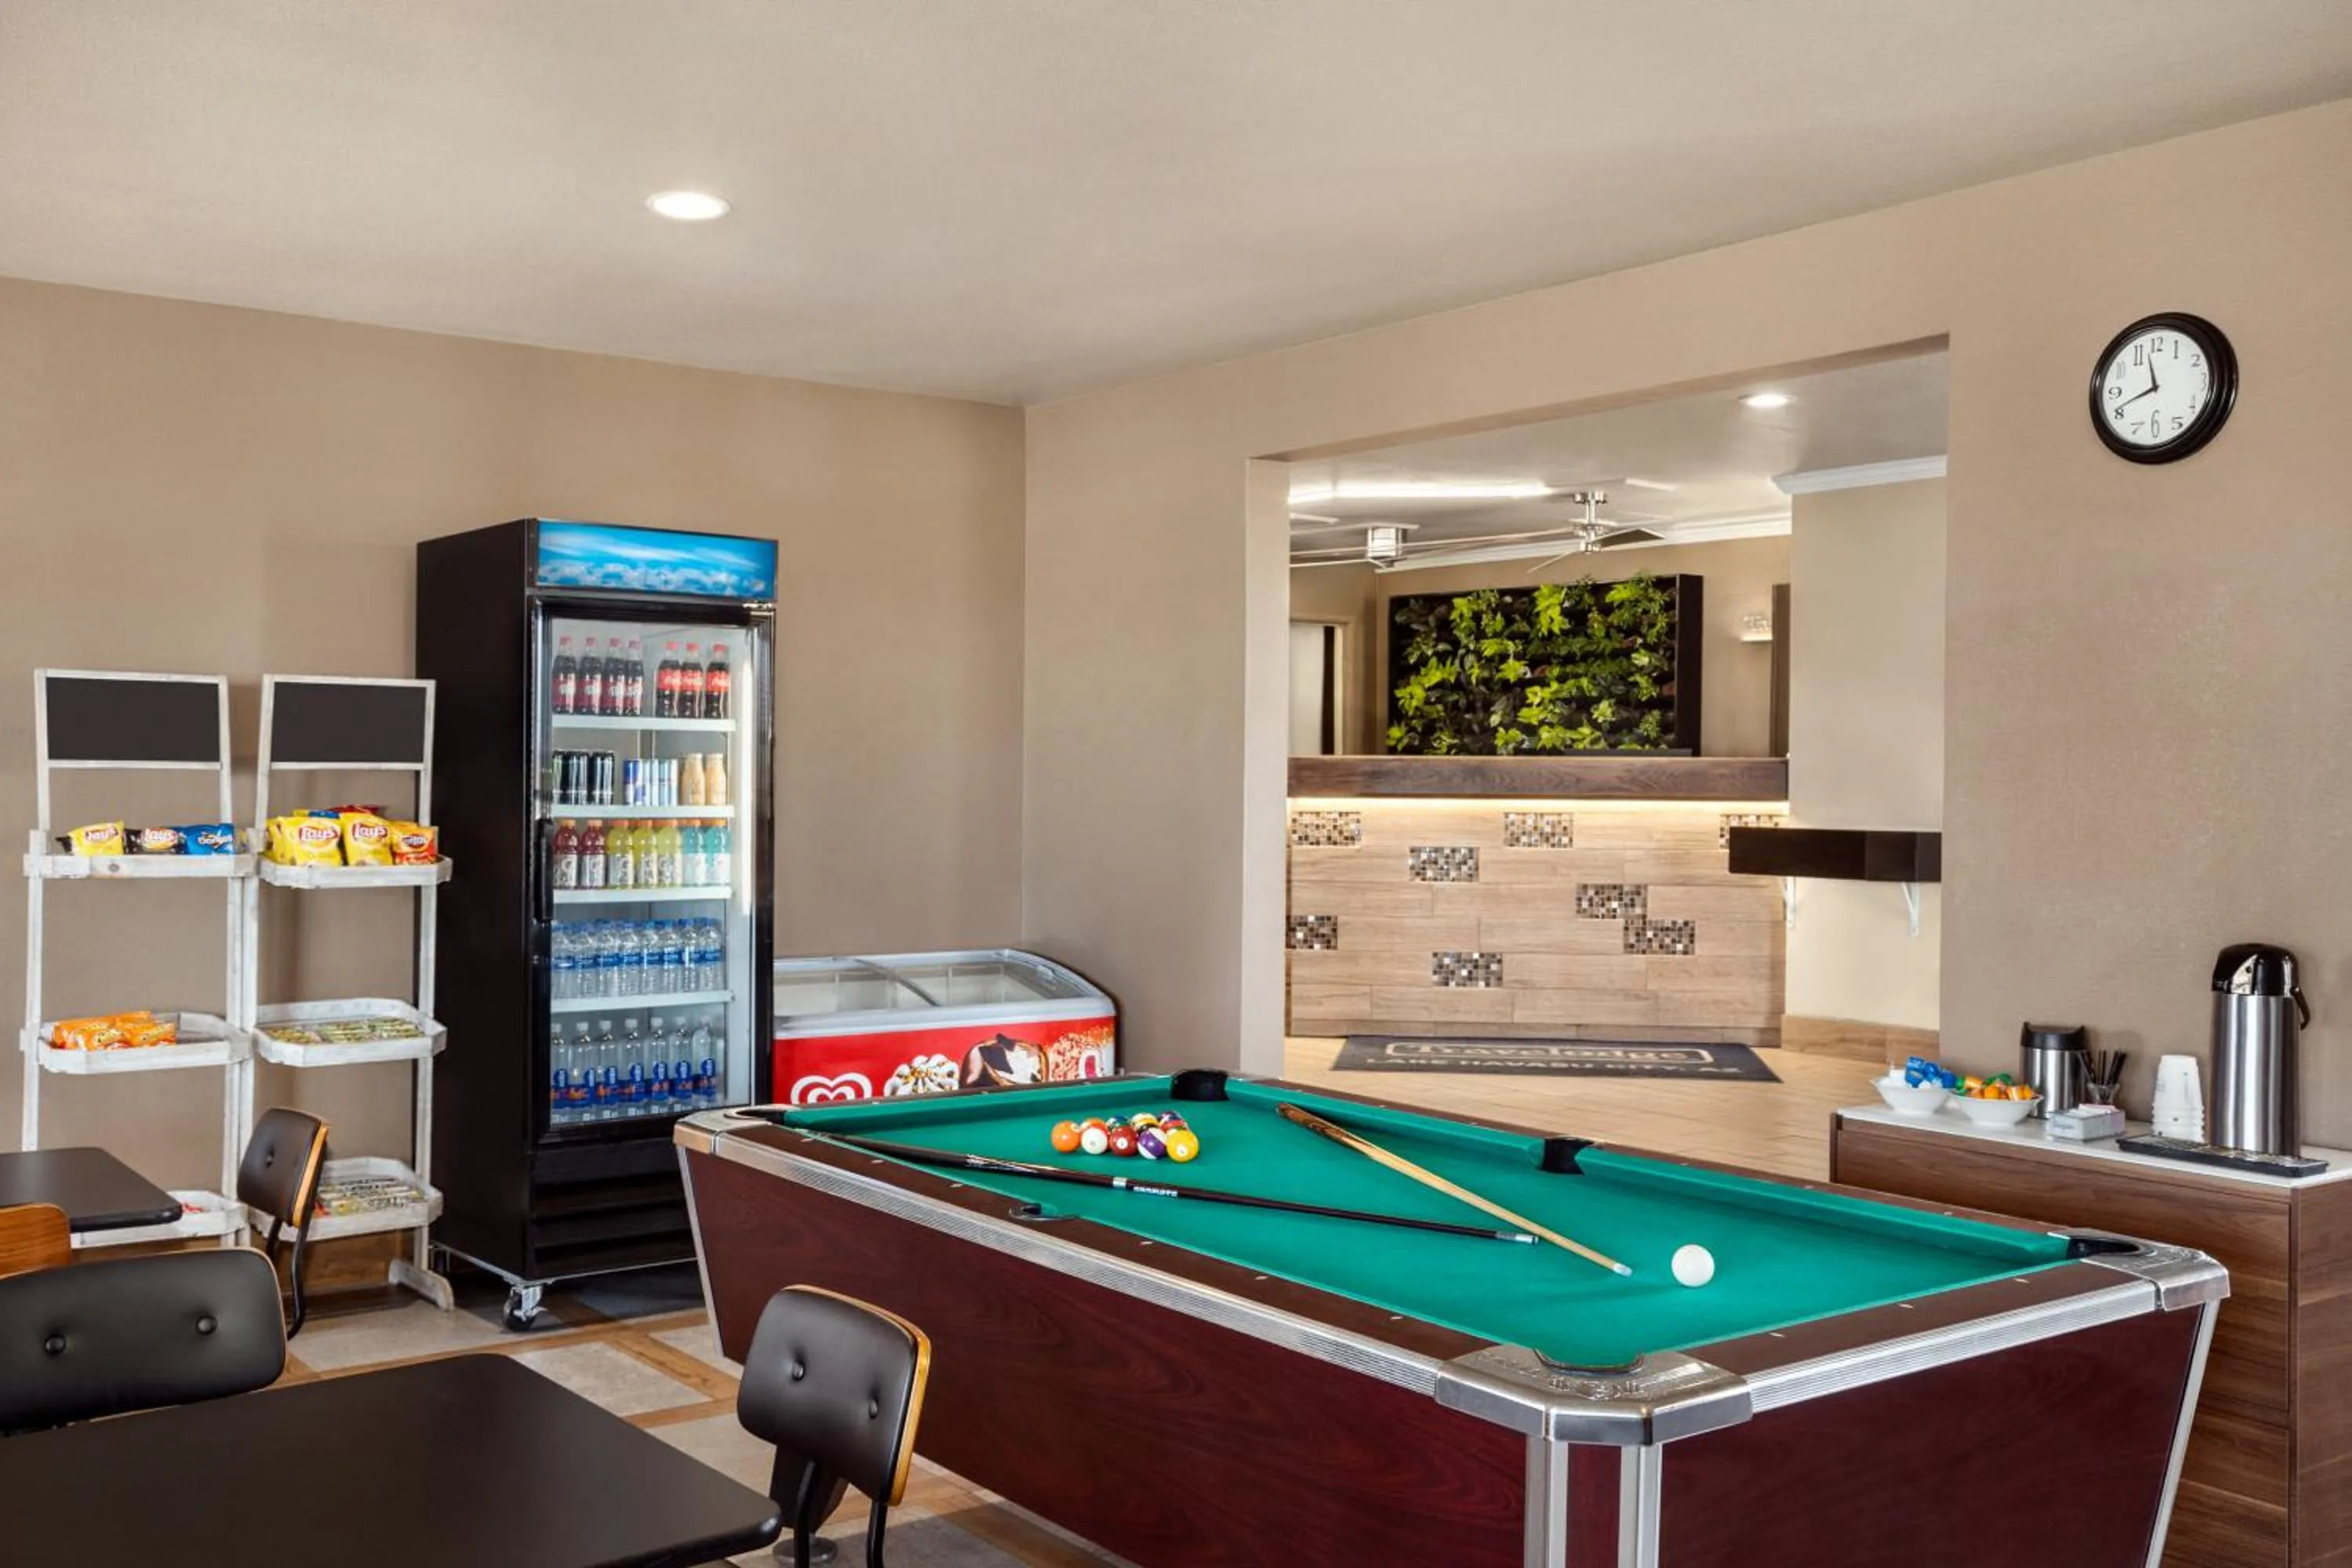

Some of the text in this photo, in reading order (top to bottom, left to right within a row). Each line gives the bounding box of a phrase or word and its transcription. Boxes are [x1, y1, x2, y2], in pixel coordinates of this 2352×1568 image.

[2151, 336, 2164, 353] 12
[2173, 339, 2179, 360] 1
[2132, 344, 2143, 366] 11
[2190, 354, 2201, 368] 2
[2201, 372, 2207, 391] 3
[2108, 386, 2122, 400] 9
[2188, 394, 2196, 415] 4
[2114, 408, 2125, 419] 8
[2130, 421, 2146, 435] 7
[2151, 409, 2160, 438] 6
[2171, 416, 2183, 430] 5
